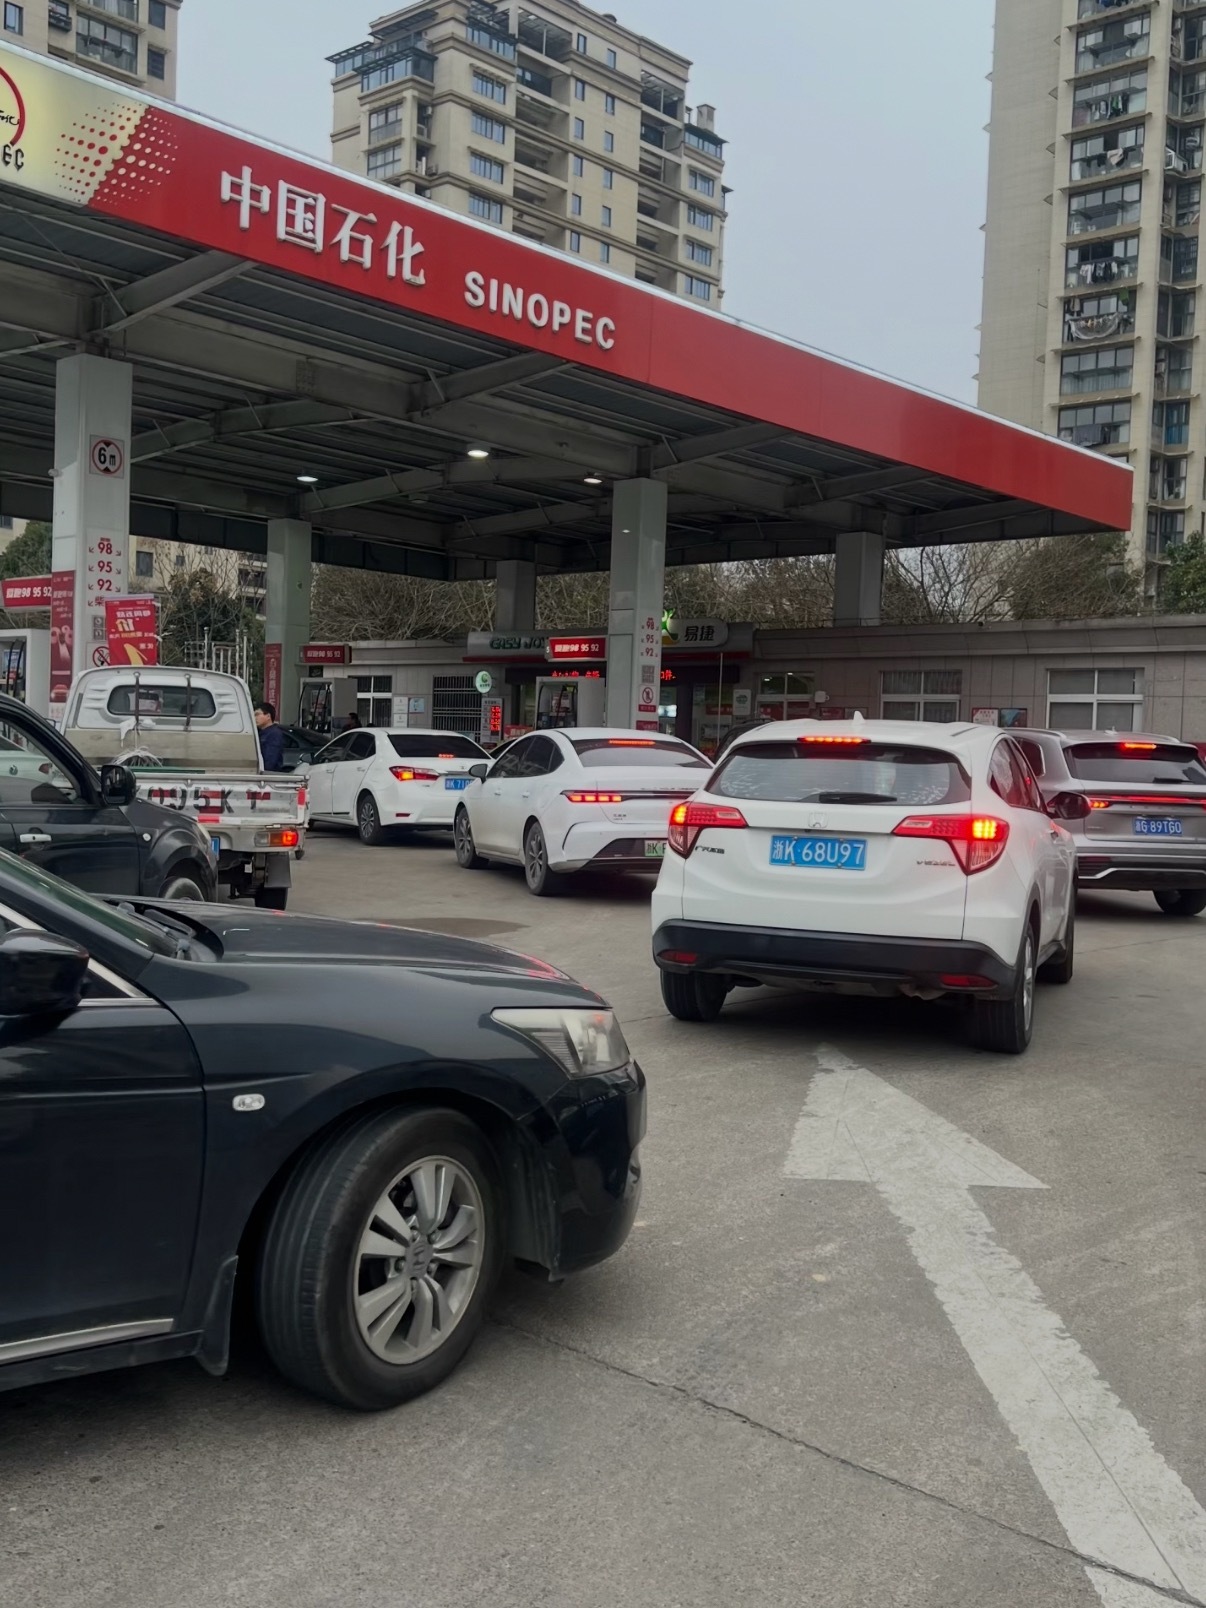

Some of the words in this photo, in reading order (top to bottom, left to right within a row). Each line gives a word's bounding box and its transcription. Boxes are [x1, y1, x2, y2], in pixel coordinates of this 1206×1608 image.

[220, 165, 426, 286] 中国石化
[464, 271, 616, 350] SINOPEC
[97, 541, 113, 555] 98
[97, 560, 113, 573] 95
[97, 579, 112, 591] 92
[33, 587, 42, 597] 95
[43, 587, 52, 597] 92
[646, 620, 655, 630] 98
[645, 634, 654, 644] 95
[684, 625, 715, 641] 易捷
[581, 644, 589, 652] 95
[591, 644, 600, 652] 92
[645, 647, 654, 657] 92
